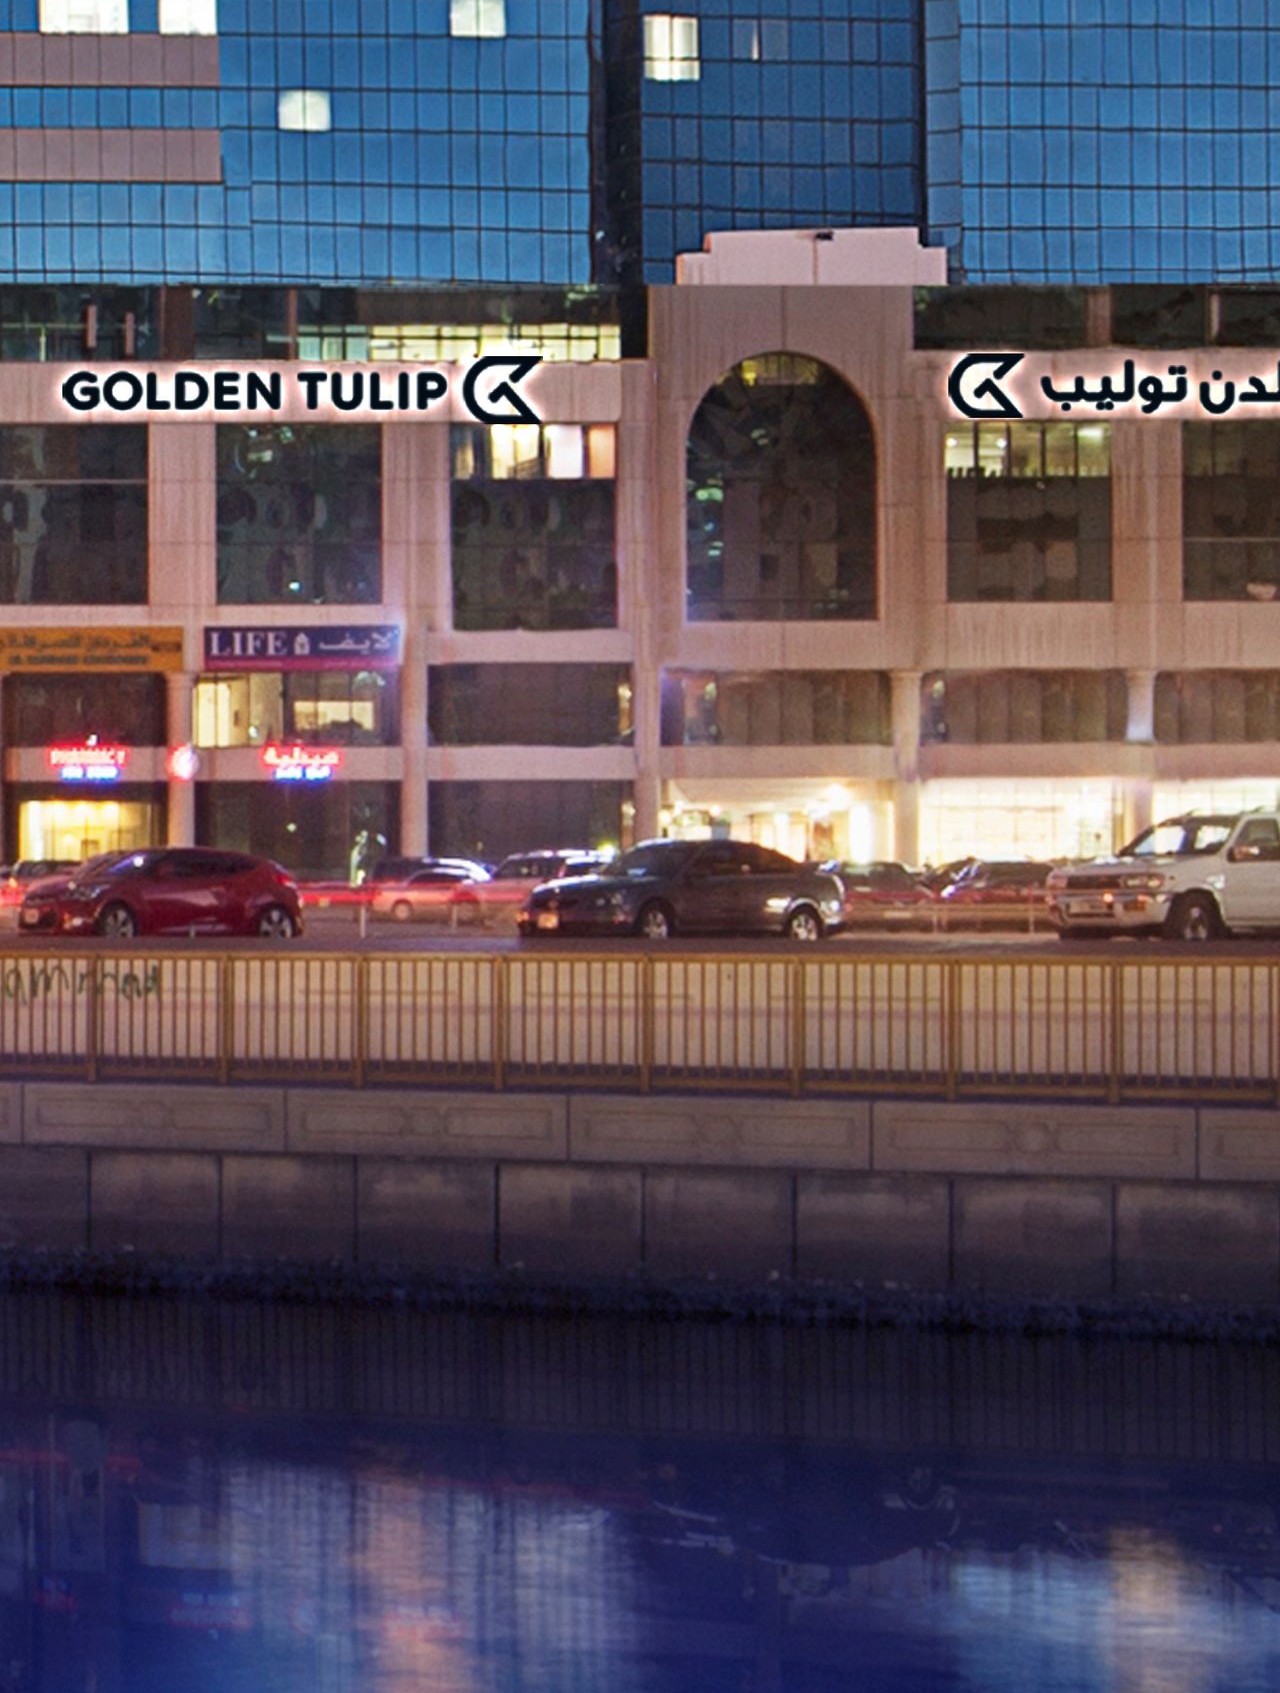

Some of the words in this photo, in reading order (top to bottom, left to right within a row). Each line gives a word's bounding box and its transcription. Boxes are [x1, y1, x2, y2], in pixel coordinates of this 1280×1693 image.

[62, 371, 282, 411] GOLDEN
[297, 371, 448, 411] TULIP
[1040, 359, 1188, 415] توليب
[209, 631, 288, 657] LIFE
[318, 631, 393, 656] لايف
